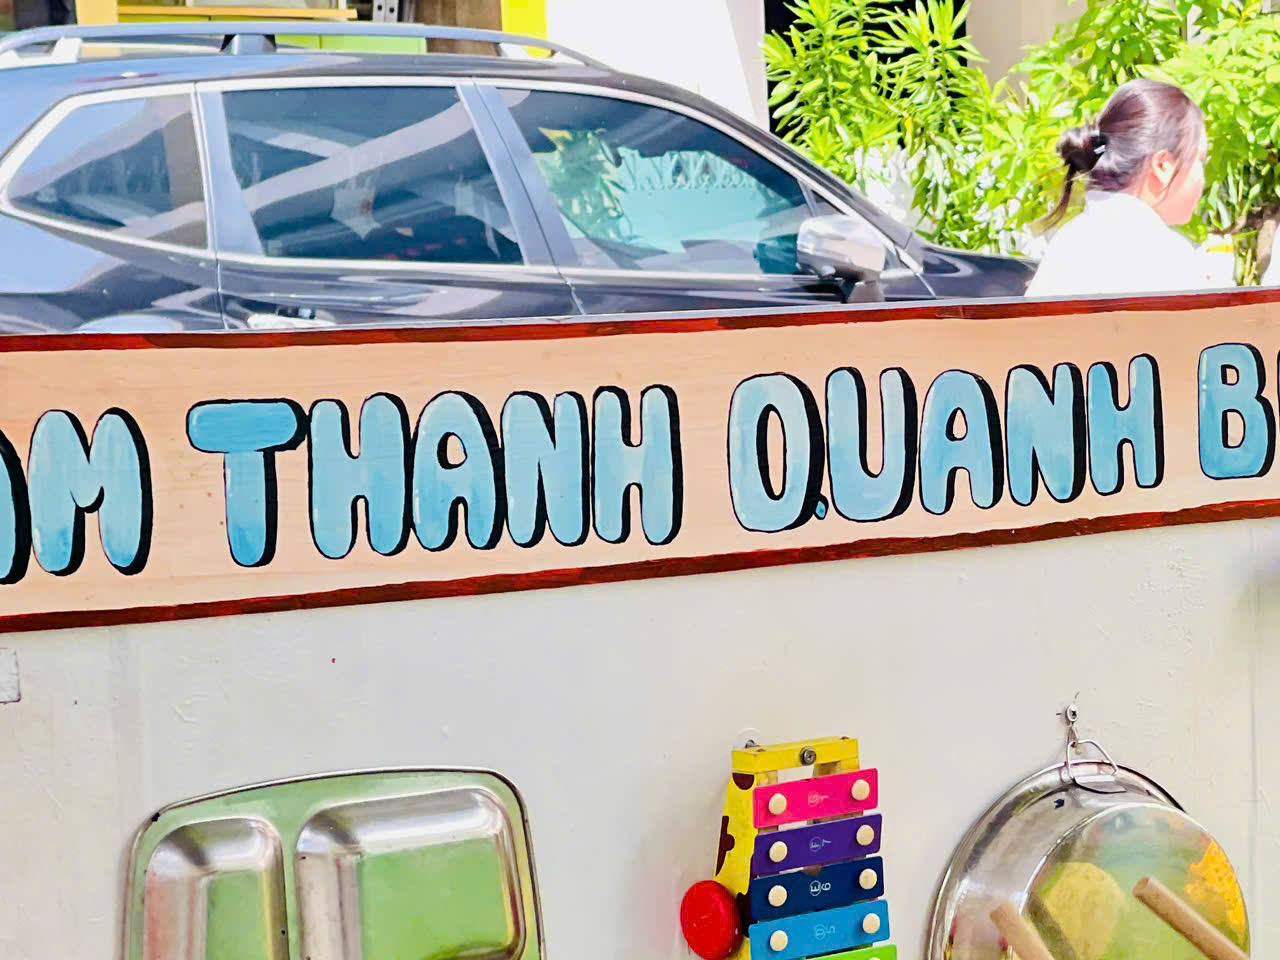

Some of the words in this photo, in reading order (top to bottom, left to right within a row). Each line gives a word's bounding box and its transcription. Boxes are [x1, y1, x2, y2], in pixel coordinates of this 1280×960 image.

[186, 383, 684, 567] THANH
[728, 353, 1164, 533] QUANH
[821, 882, 831, 891] 6
